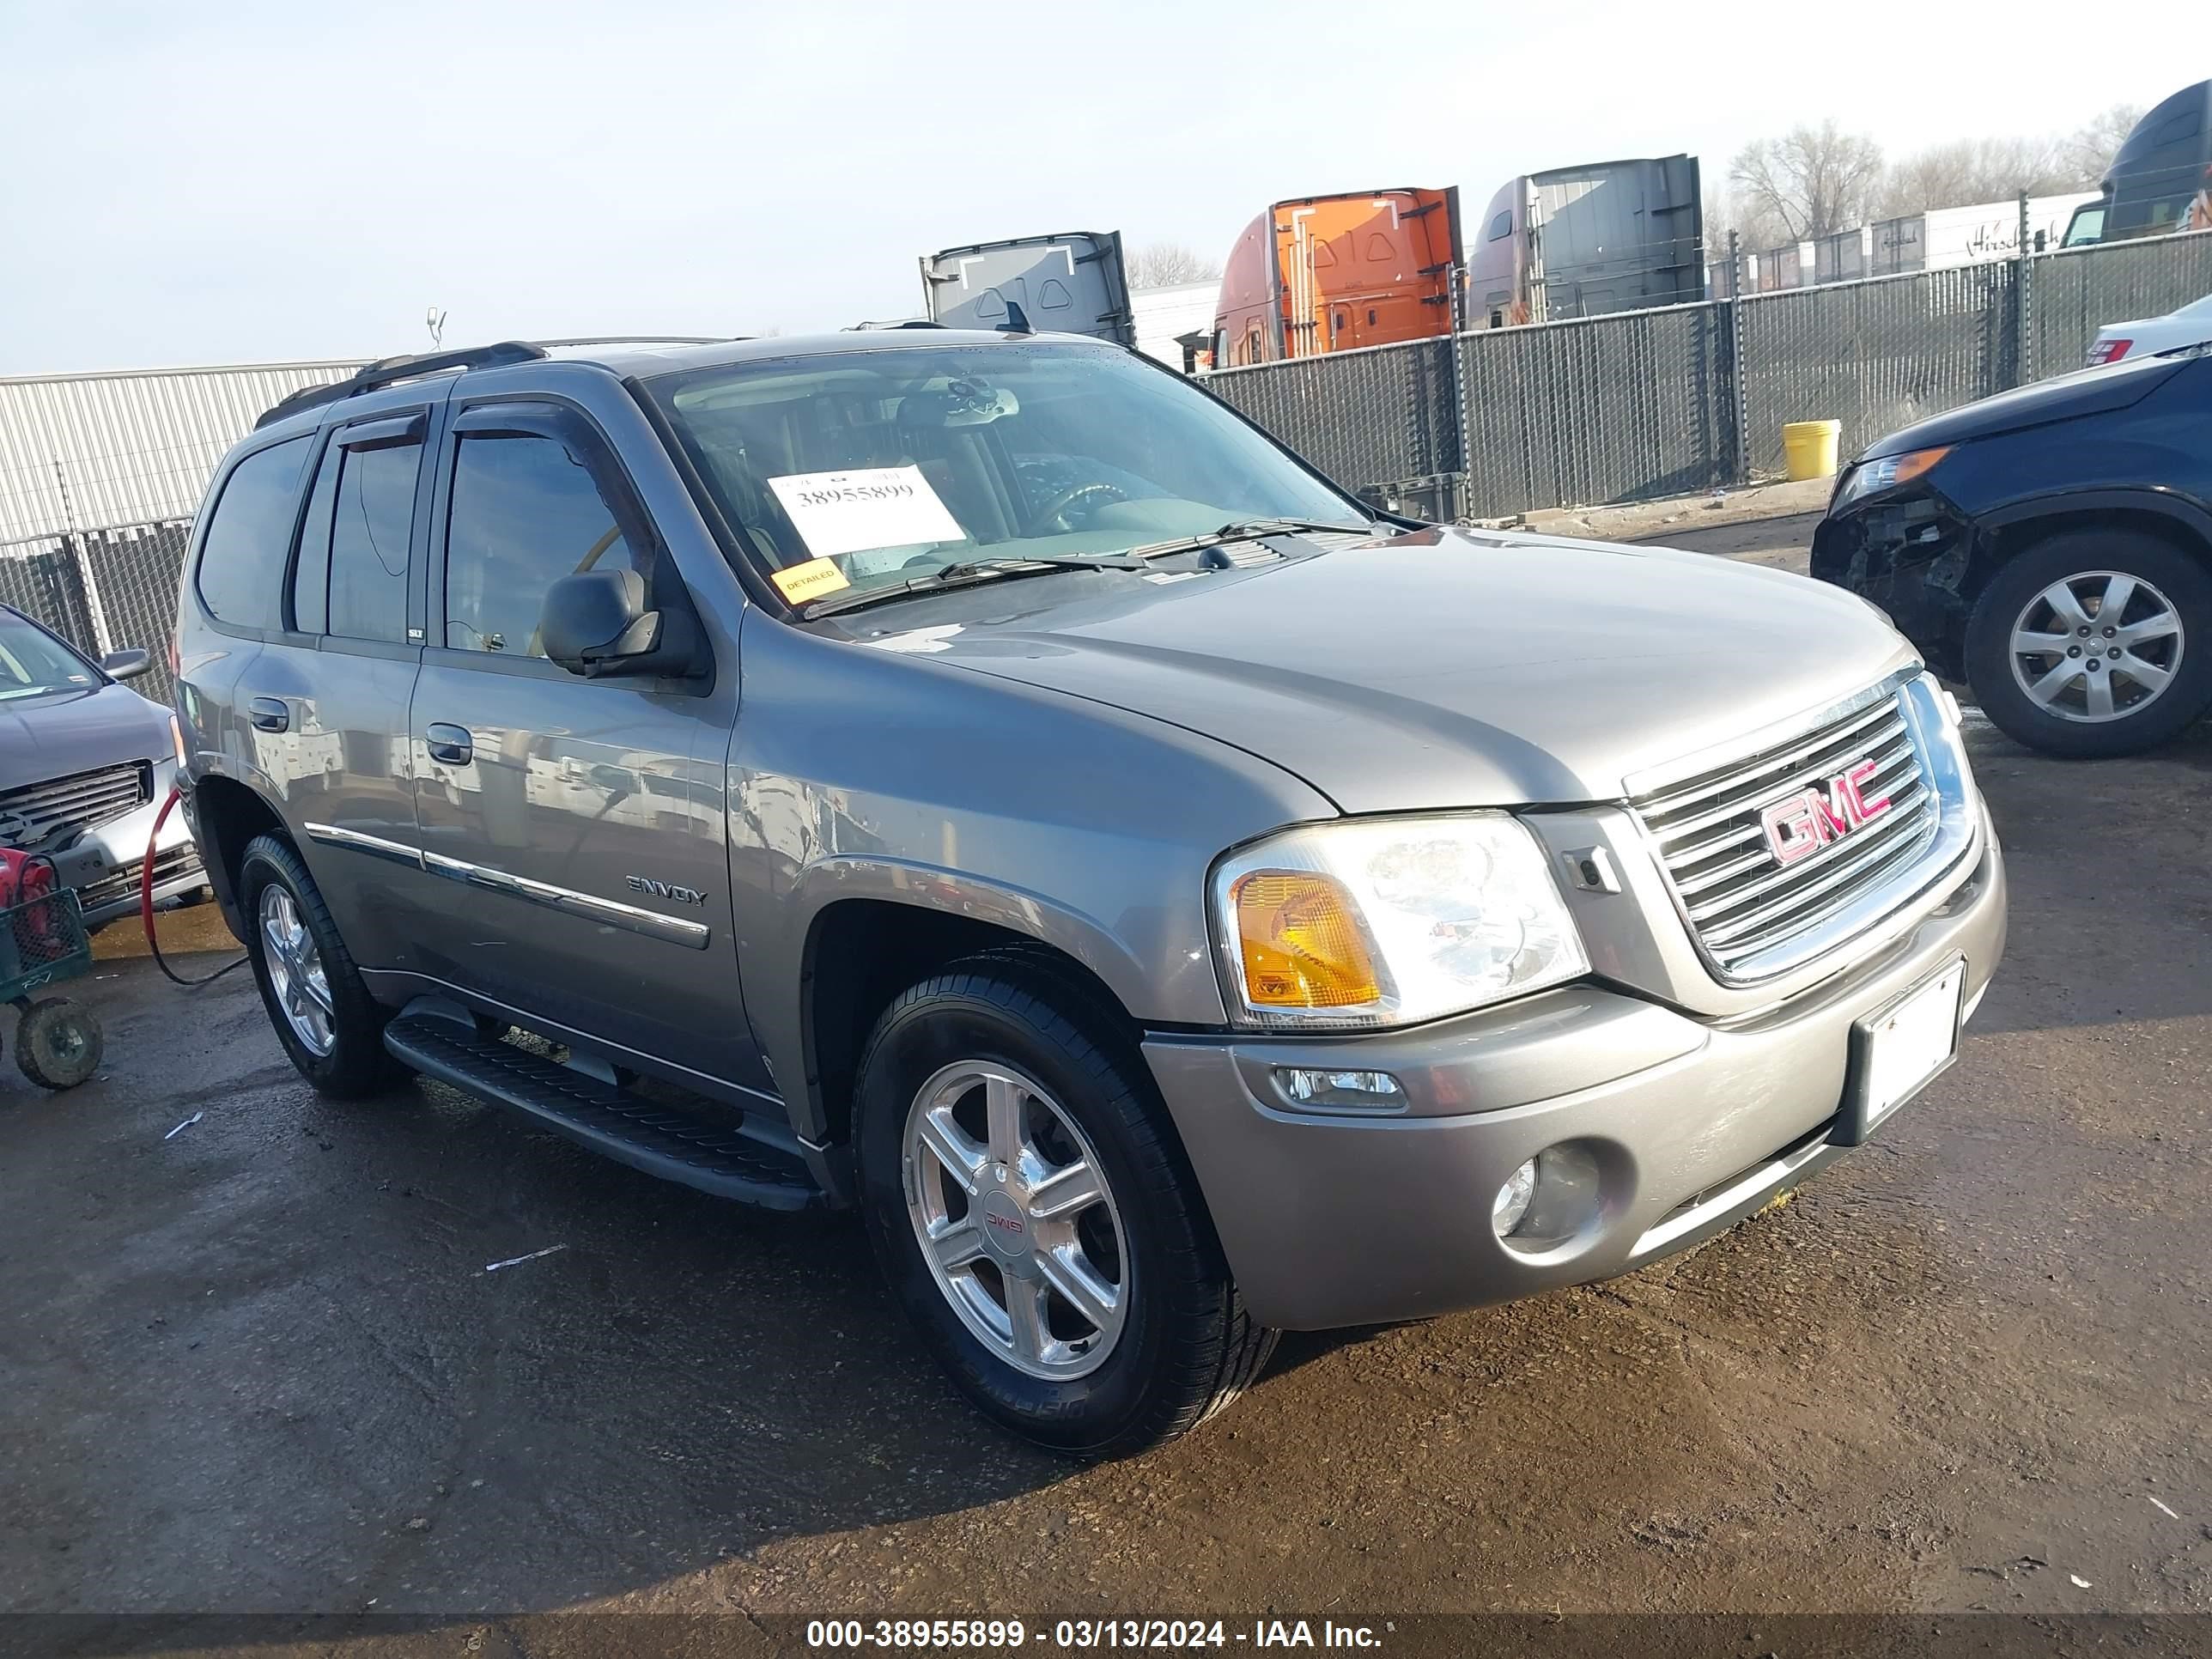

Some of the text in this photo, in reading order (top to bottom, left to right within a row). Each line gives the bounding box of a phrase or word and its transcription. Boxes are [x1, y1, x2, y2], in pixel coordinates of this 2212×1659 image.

[1966, 220, 2059, 257] Hirschh
[796, 484, 914, 507] 38955899
[787, 569, 836, 591] DETAILED
[408, 629, 423, 639] SLT
[1760, 757, 1892, 866] GMC
[625, 875, 708, 907] ENVOY
[986, 1210, 1024, 1235] GMC
